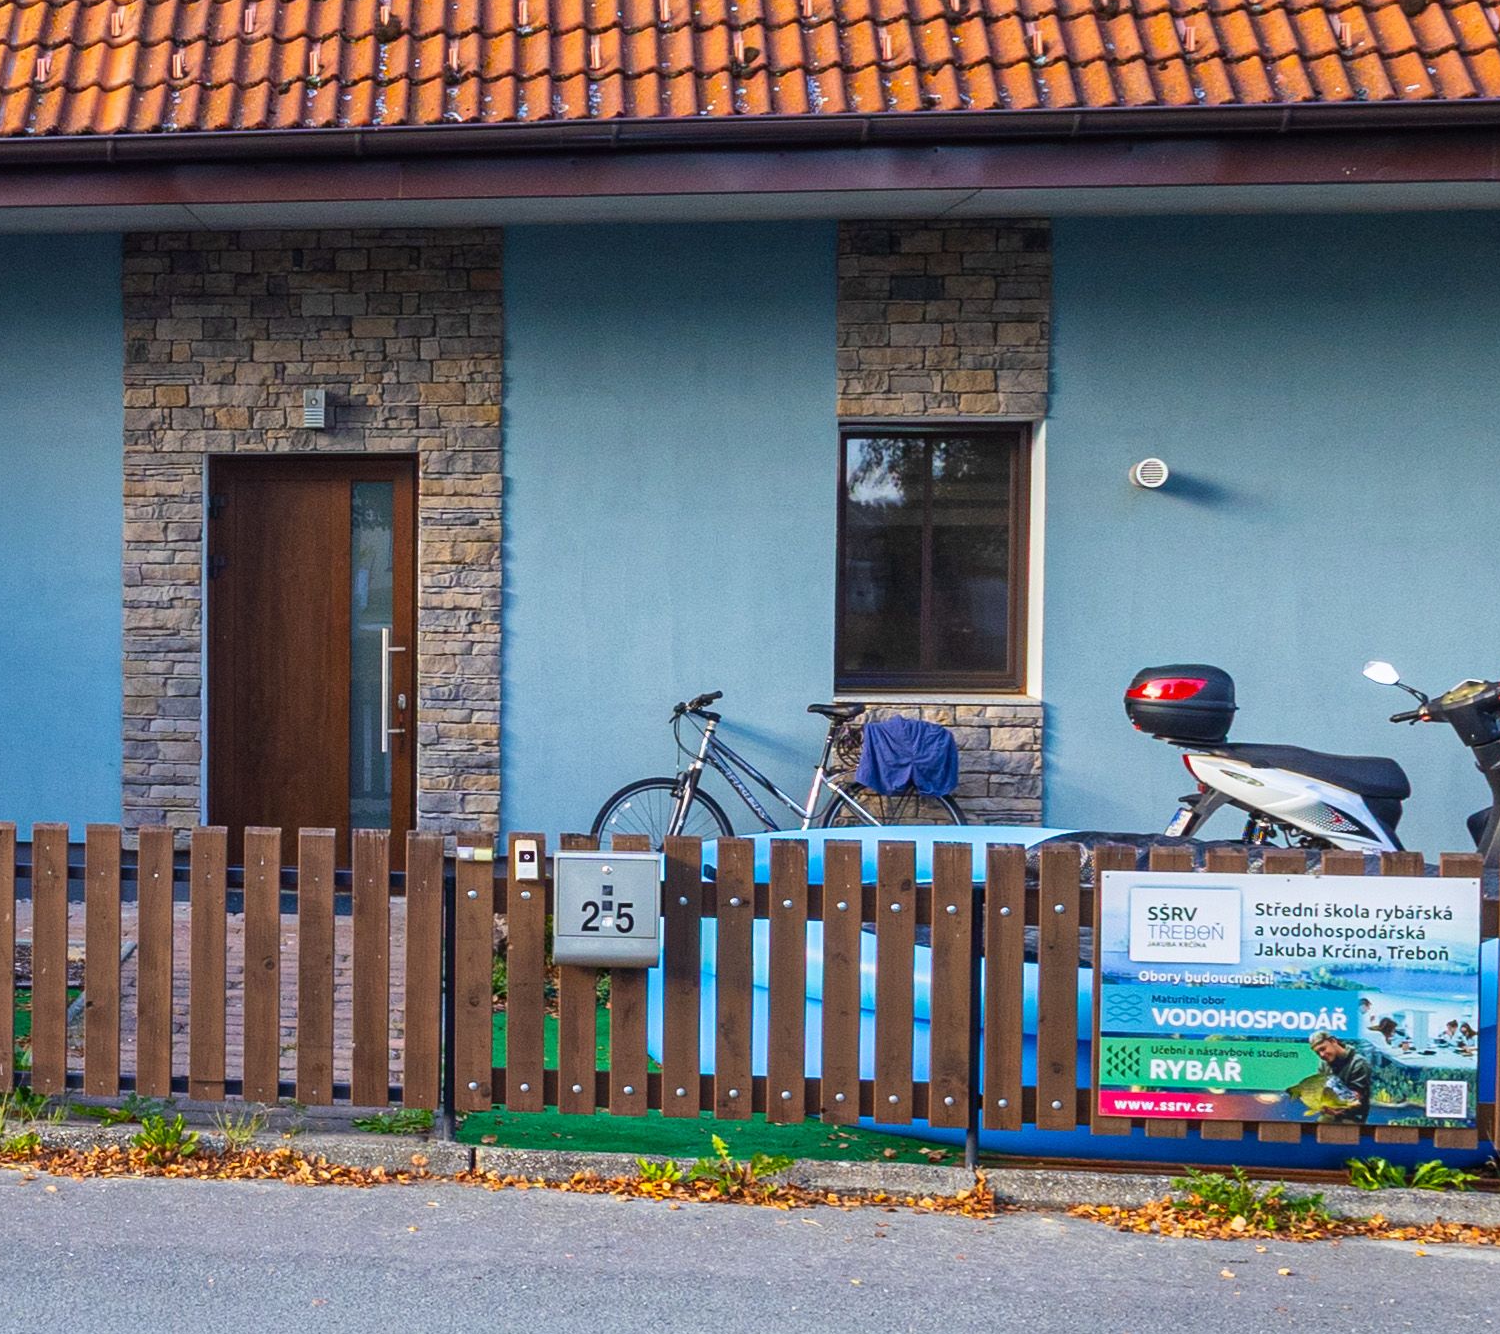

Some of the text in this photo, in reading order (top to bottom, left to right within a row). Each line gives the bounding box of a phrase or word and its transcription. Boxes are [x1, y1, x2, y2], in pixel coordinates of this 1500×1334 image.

[581, 901, 634, 933] 25
[1148, 903, 1198, 921] SŠRV
[1255, 902, 1453, 922] Střední škola rybářská
[1147, 921, 1225, 940] TŘEBOŇ
[1254, 923, 1426, 941] a vodohospodářská
[1254, 943, 1449, 962] Jakuba Krčína, Třeboň
[1138, 970, 1274, 986] Obory budoucnosti!
[1151, 994, 1226, 1005] Maturitní obor
[1151, 1006, 1347, 1031] VODOHOSPODÁŘ
[1150, 1044, 1299, 1058] Učební a nástavbové studium
[1150, 1057, 1242, 1083] RYBÁŘ
[1114, 1099, 1214, 1113] www.ssrv.cz
